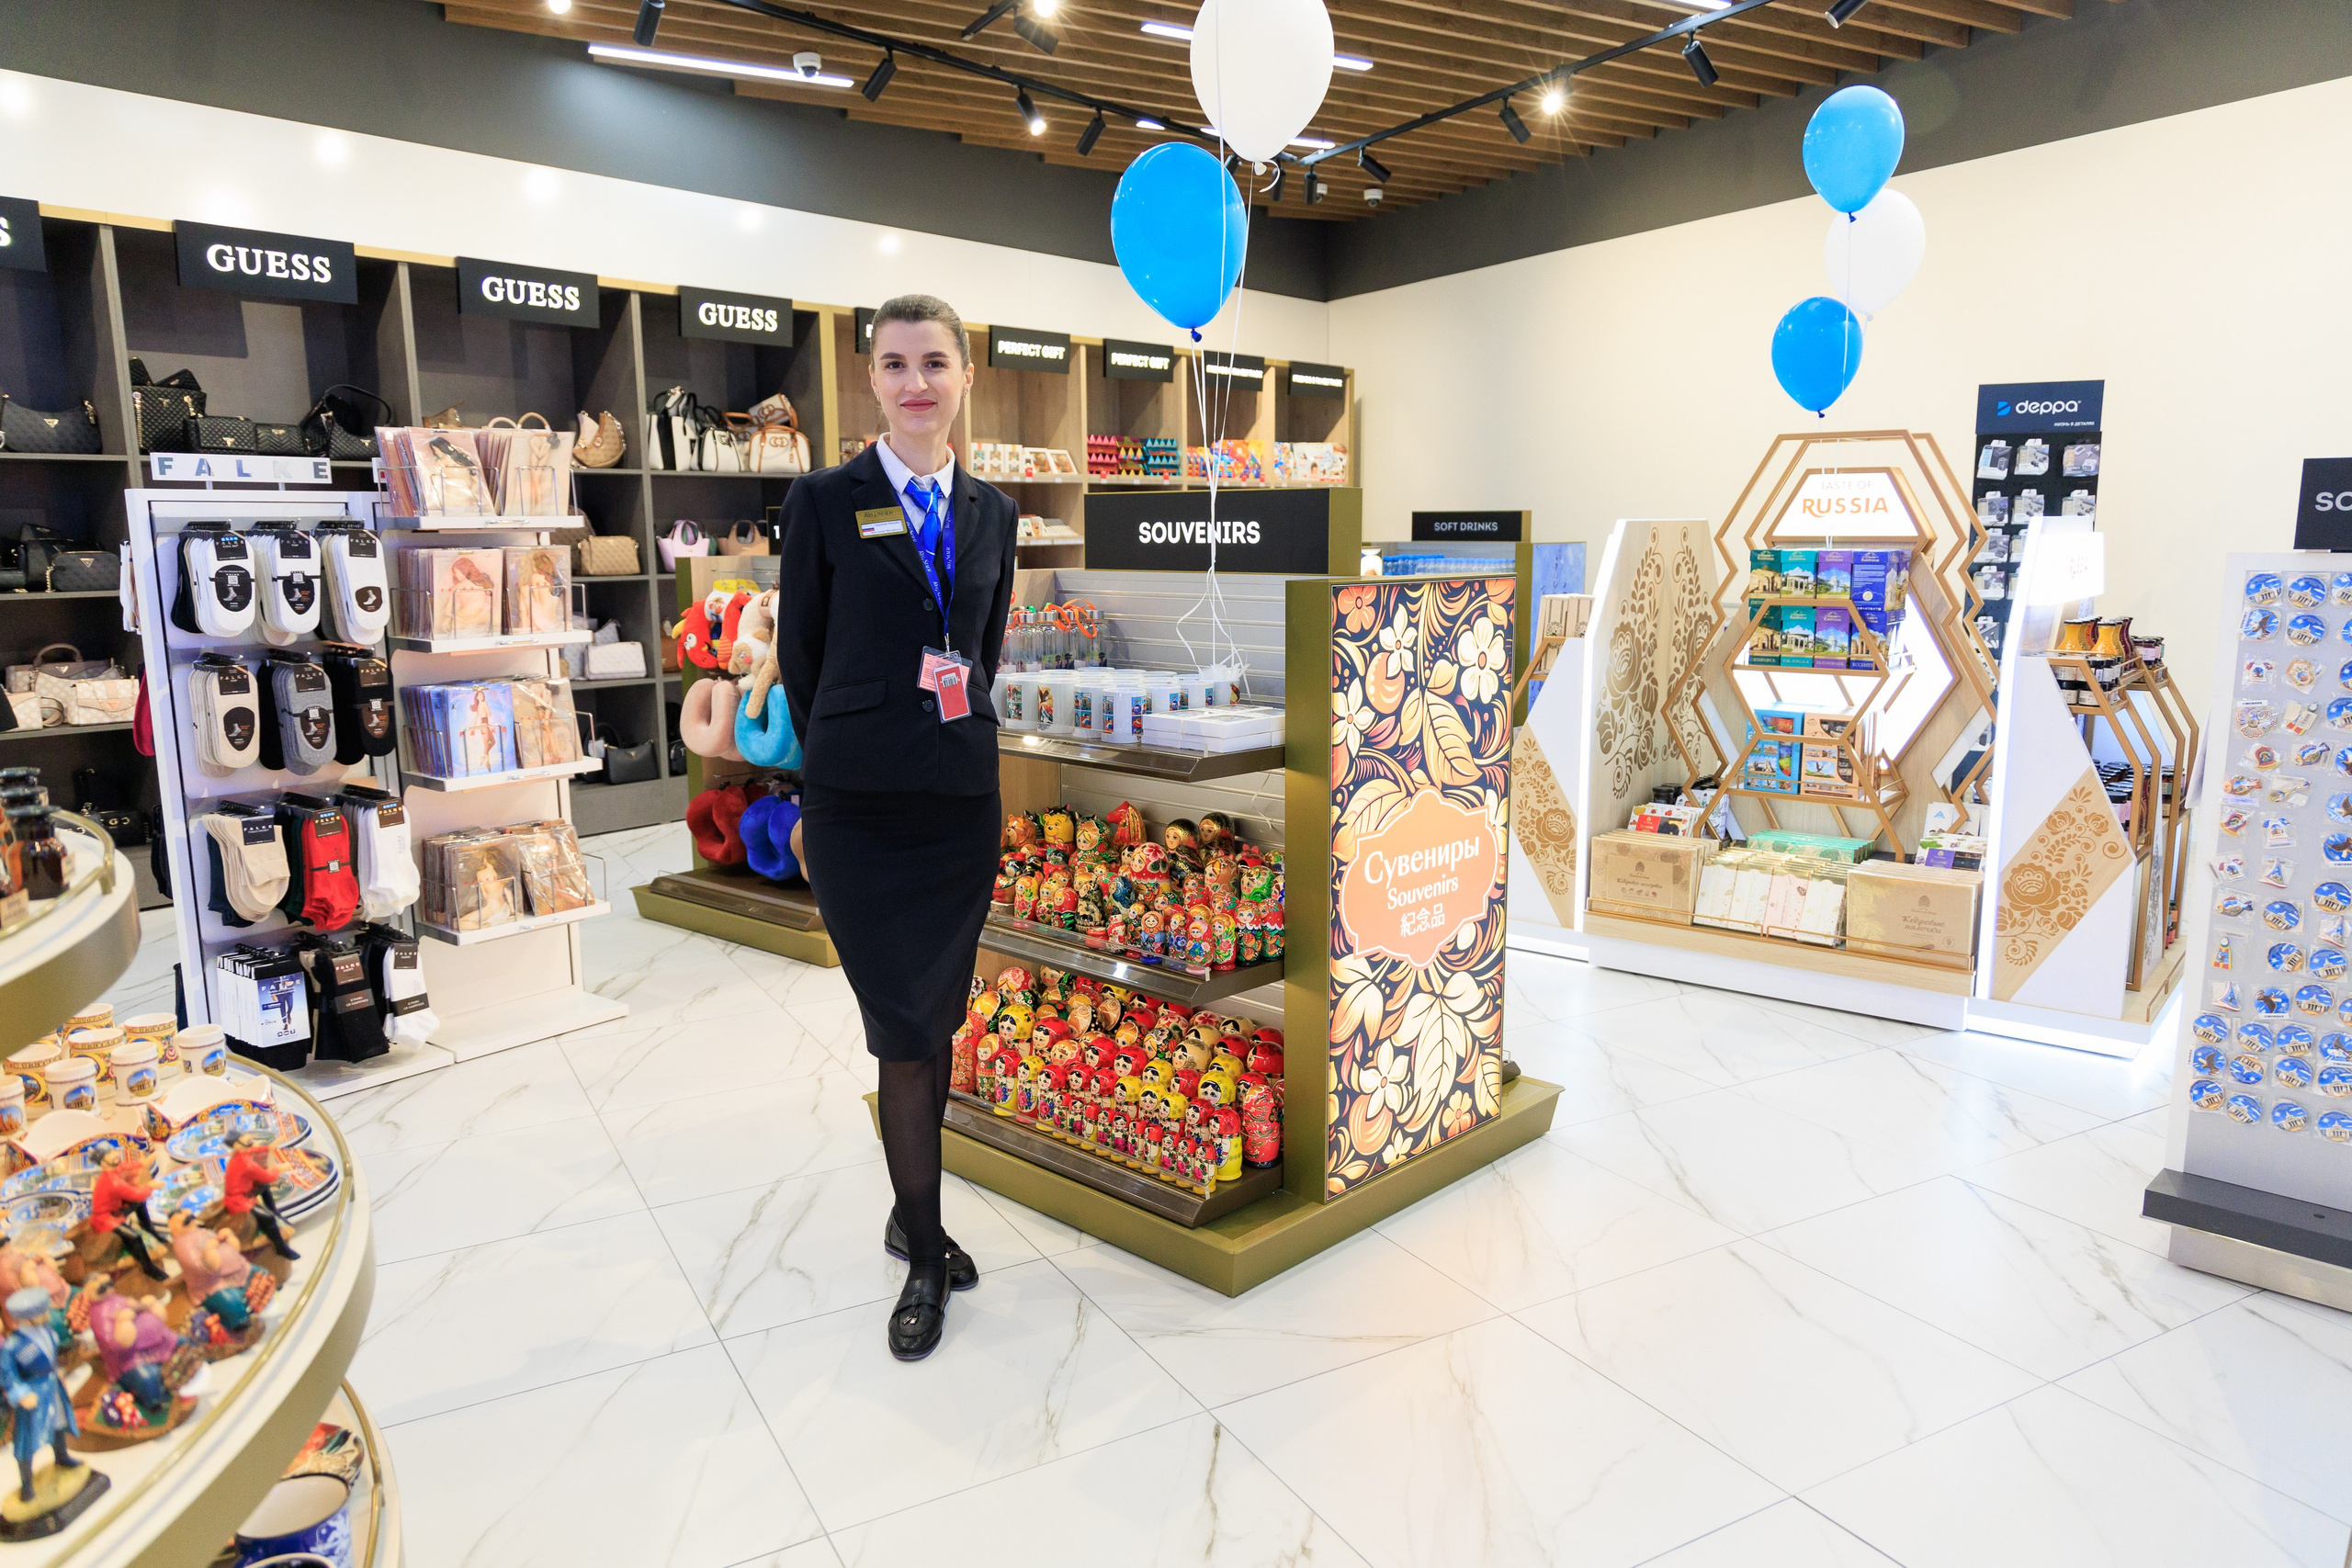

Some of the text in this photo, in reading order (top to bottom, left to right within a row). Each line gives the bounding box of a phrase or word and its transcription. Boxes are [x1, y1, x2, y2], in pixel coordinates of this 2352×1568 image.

[206, 243, 333, 284] GUESS
[481, 276, 581, 311] GUESS
[698, 301, 779, 333] GUESS
[997, 339, 1066, 360] PERFECT GIFT
[1111, 352, 1149, 368] PERFECT
[2015, 400, 2078, 415] deppa
[157, 457, 329, 479] FALKE
[1802, 497, 1888, 518] RUSSIA
[1138, 521, 1261, 545] SOUVENIRS
[1433, 521, 1498, 533] SOFT DRINKS
[1363, 836, 1480, 889] Сувениры
[1387, 874, 1459, 910] Souvenirs
[1400, 903, 1445, 938] 紀念品
